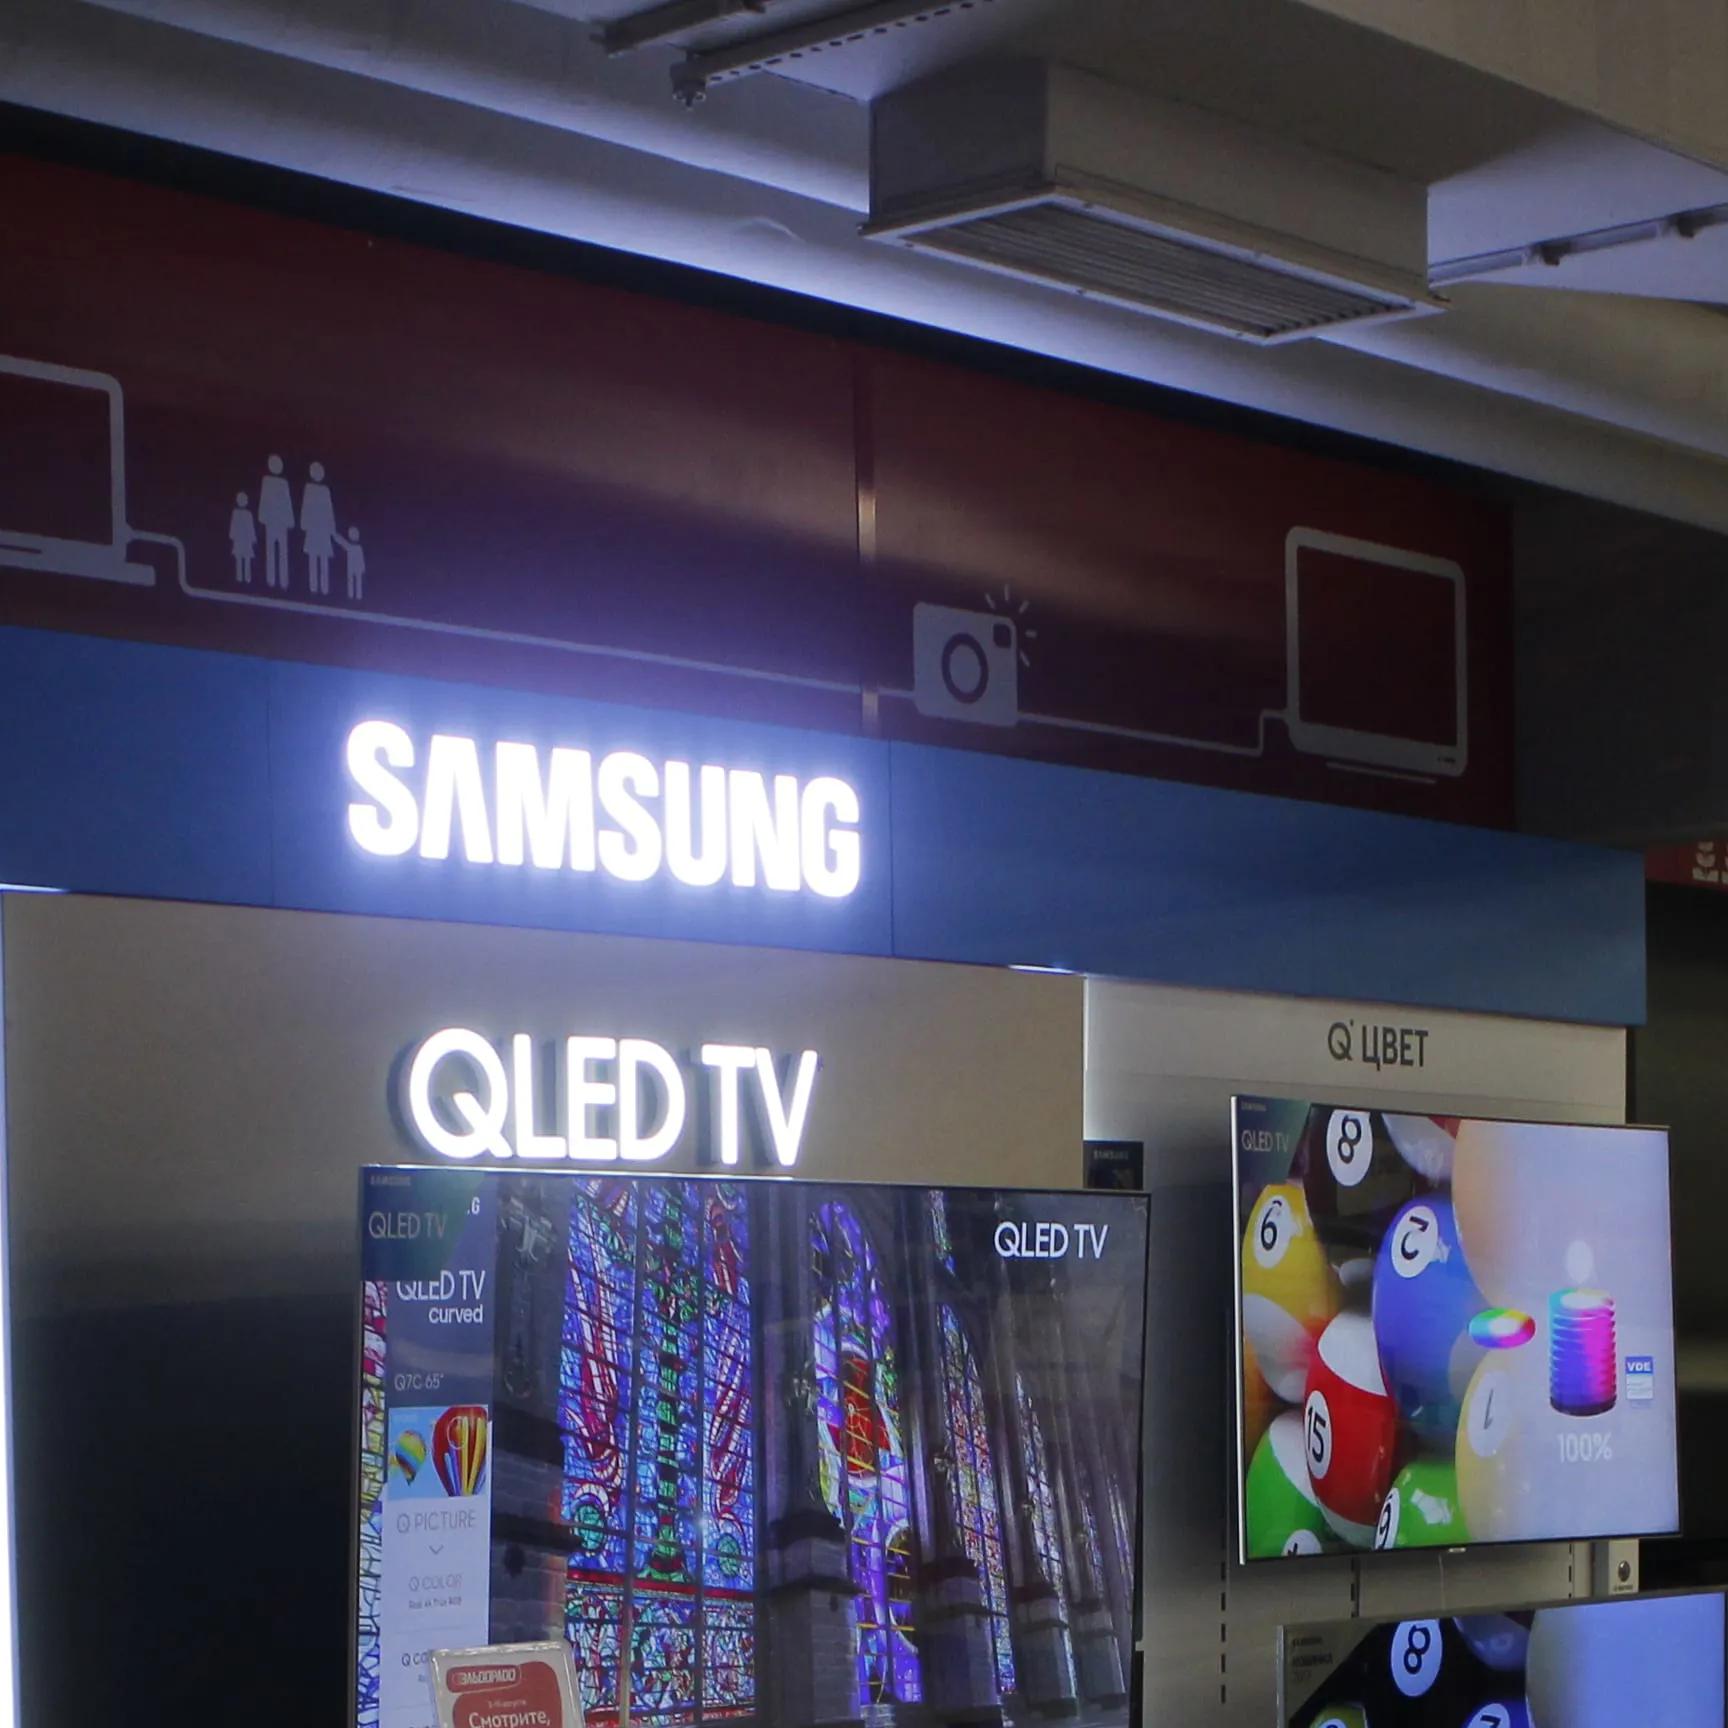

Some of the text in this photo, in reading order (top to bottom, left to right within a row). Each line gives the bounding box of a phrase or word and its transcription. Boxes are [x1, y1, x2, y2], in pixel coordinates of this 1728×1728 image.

[347, 720, 860, 898] SAMSUNG
[1362, 1024, 1429, 1072] ЦВЕТ
[409, 1027, 818, 1165] QLED TV
[1241, 1130, 1271, 1152] QLED
[368, 1211, 449, 1240] QLED TV
[994, 1221, 1109, 1259] QLED TV
[459, 1270, 487, 1301] TV
[428, 1304, 484, 1324] curved
[394, 1374, 422, 1391] Q7C
[1626, 1361, 1653, 1373] VDE
[1308, 1406, 1328, 1463] 15
[1556, 1432, 1613, 1464] 100%
[414, 1510, 477, 1531] PICTURE
